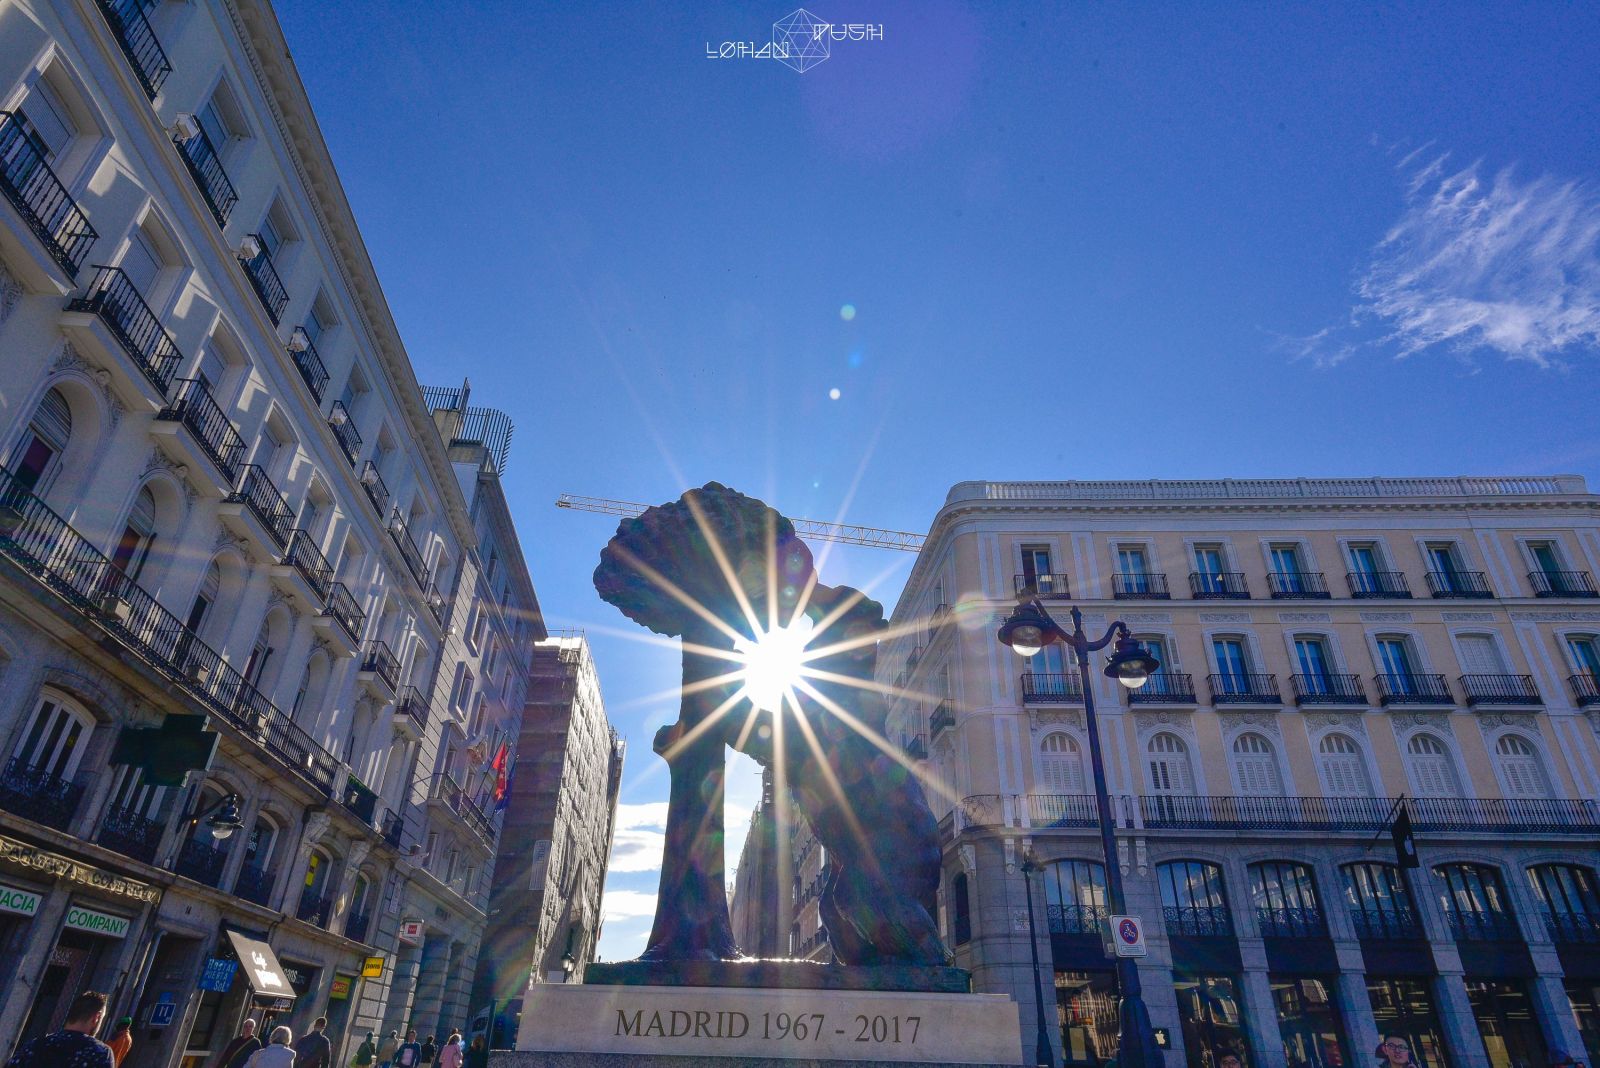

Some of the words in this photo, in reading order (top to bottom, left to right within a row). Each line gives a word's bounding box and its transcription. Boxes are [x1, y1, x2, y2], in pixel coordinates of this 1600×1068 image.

[68, 910, 127, 934] COMPANY
[614, 1009, 750, 1039] MADRID
[762, 1012, 825, 1041] 1967
[855, 1014, 921, 1044] 2017
